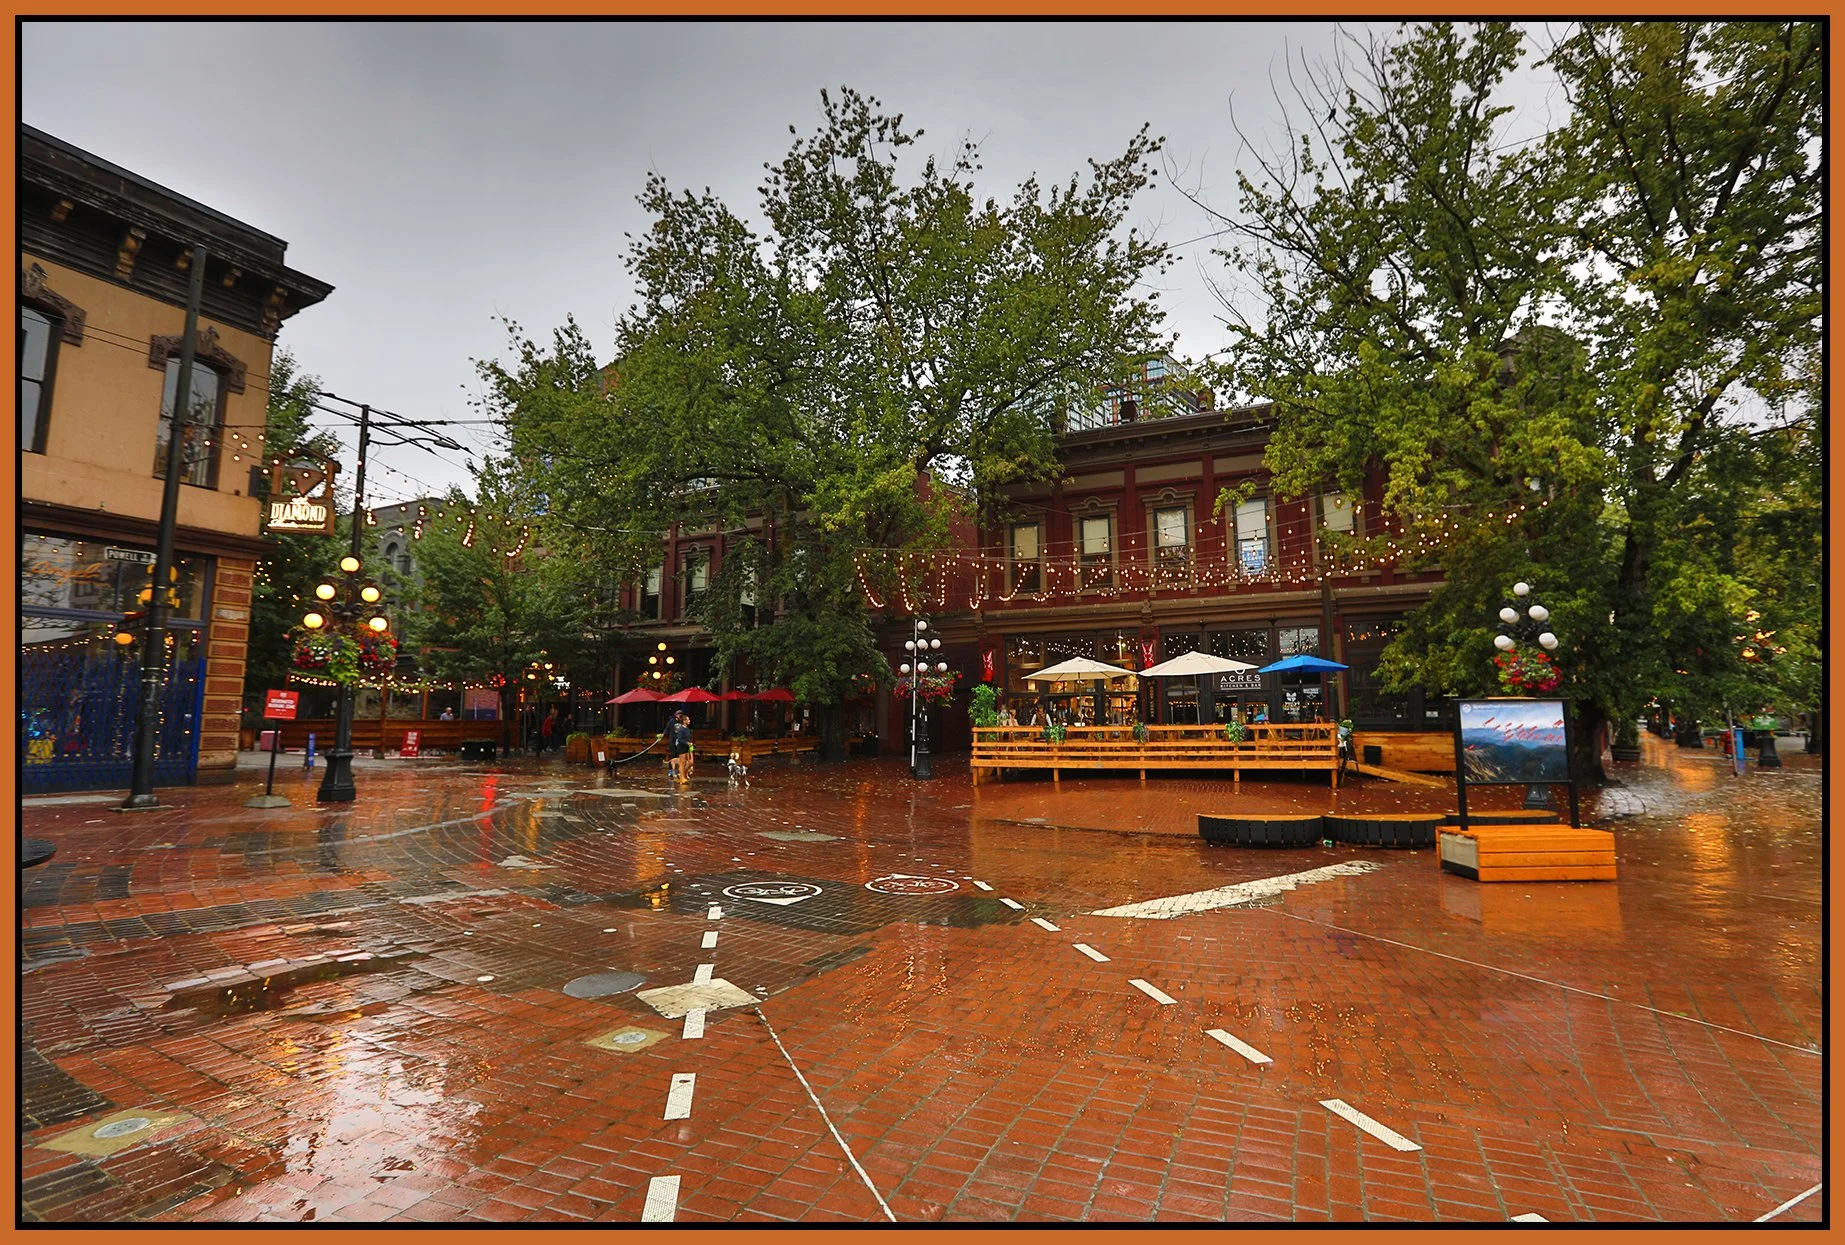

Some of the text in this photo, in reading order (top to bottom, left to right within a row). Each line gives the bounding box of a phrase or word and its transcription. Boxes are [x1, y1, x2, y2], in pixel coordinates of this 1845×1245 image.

[270, 502, 327, 522] DIAMOND
[109, 550, 138, 561] POWELL
[1220, 674, 1261, 682] ACRES
